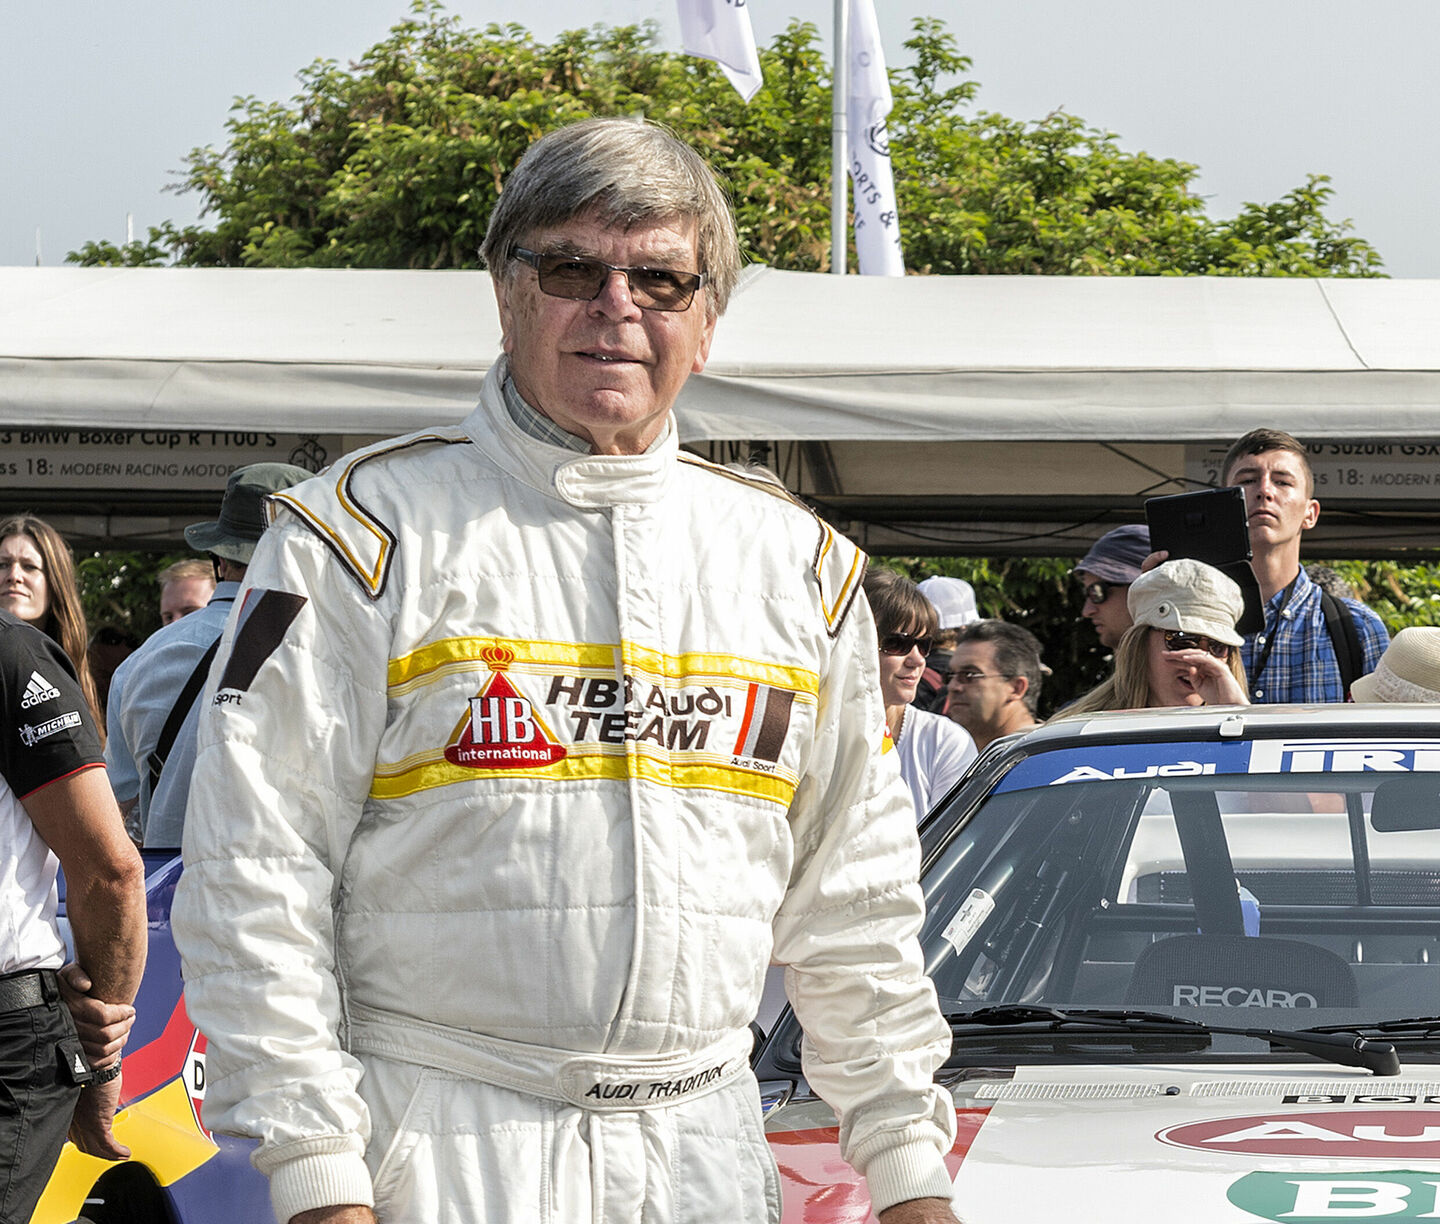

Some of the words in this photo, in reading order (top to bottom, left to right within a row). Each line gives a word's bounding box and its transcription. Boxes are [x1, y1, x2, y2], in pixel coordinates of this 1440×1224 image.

[20, 432, 70, 445] BMW
[79, 432, 132, 446] Boxer
[141, 431, 181, 449] Cup
[189, 432, 200, 446] R
[265, 433, 277, 447] S
[26, 459, 53, 475] 18:
[60, 462, 121, 476] MODERN
[125, 463, 178, 477] RACING
[1337, 469, 1364, 485] 18:
[1370, 474, 1429, 486] MODERN
[21, 687, 61, 709] adidas
[545, 676, 634, 709] HB
[468, 696, 535, 745] HB
[570, 710, 711, 751] TEAM
[457, 746, 552, 762] international
[730, 756, 752, 770] Audi
[752, 760, 776, 774] Sport
[1172, 984, 1318, 1009] RECARO
[585, 1083, 640, 1100] AUDI
